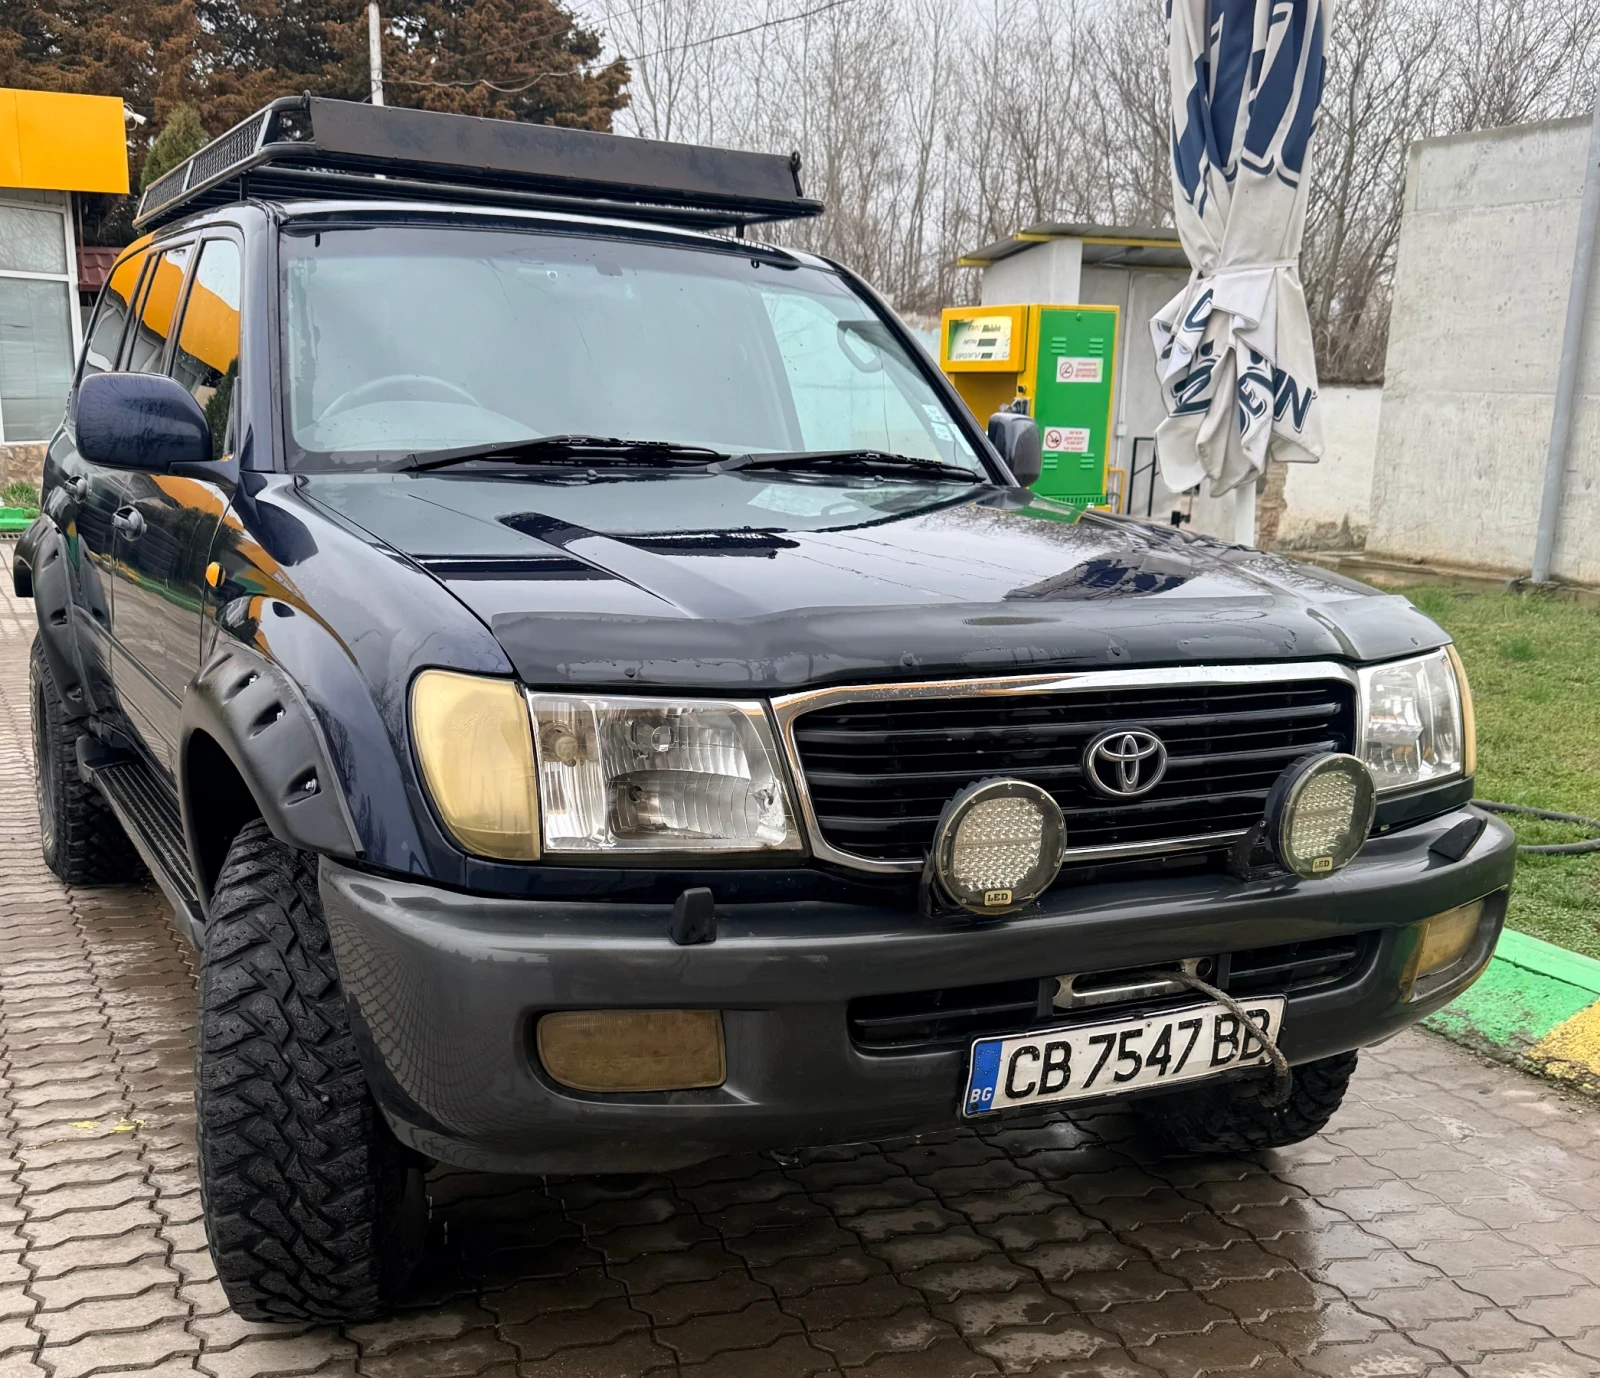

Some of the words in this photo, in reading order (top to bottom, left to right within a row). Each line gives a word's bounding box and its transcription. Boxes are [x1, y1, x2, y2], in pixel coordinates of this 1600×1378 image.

[1314, 859, 1330, 869] LED
[987, 893, 1009, 902] LED
[1004, 1040, 1072, 1099] CB
[1081, 1017, 1203, 1089] 7547
[1209, 1008, 1272, 1067] BB
[969, 1087, 993, 1104] BG
